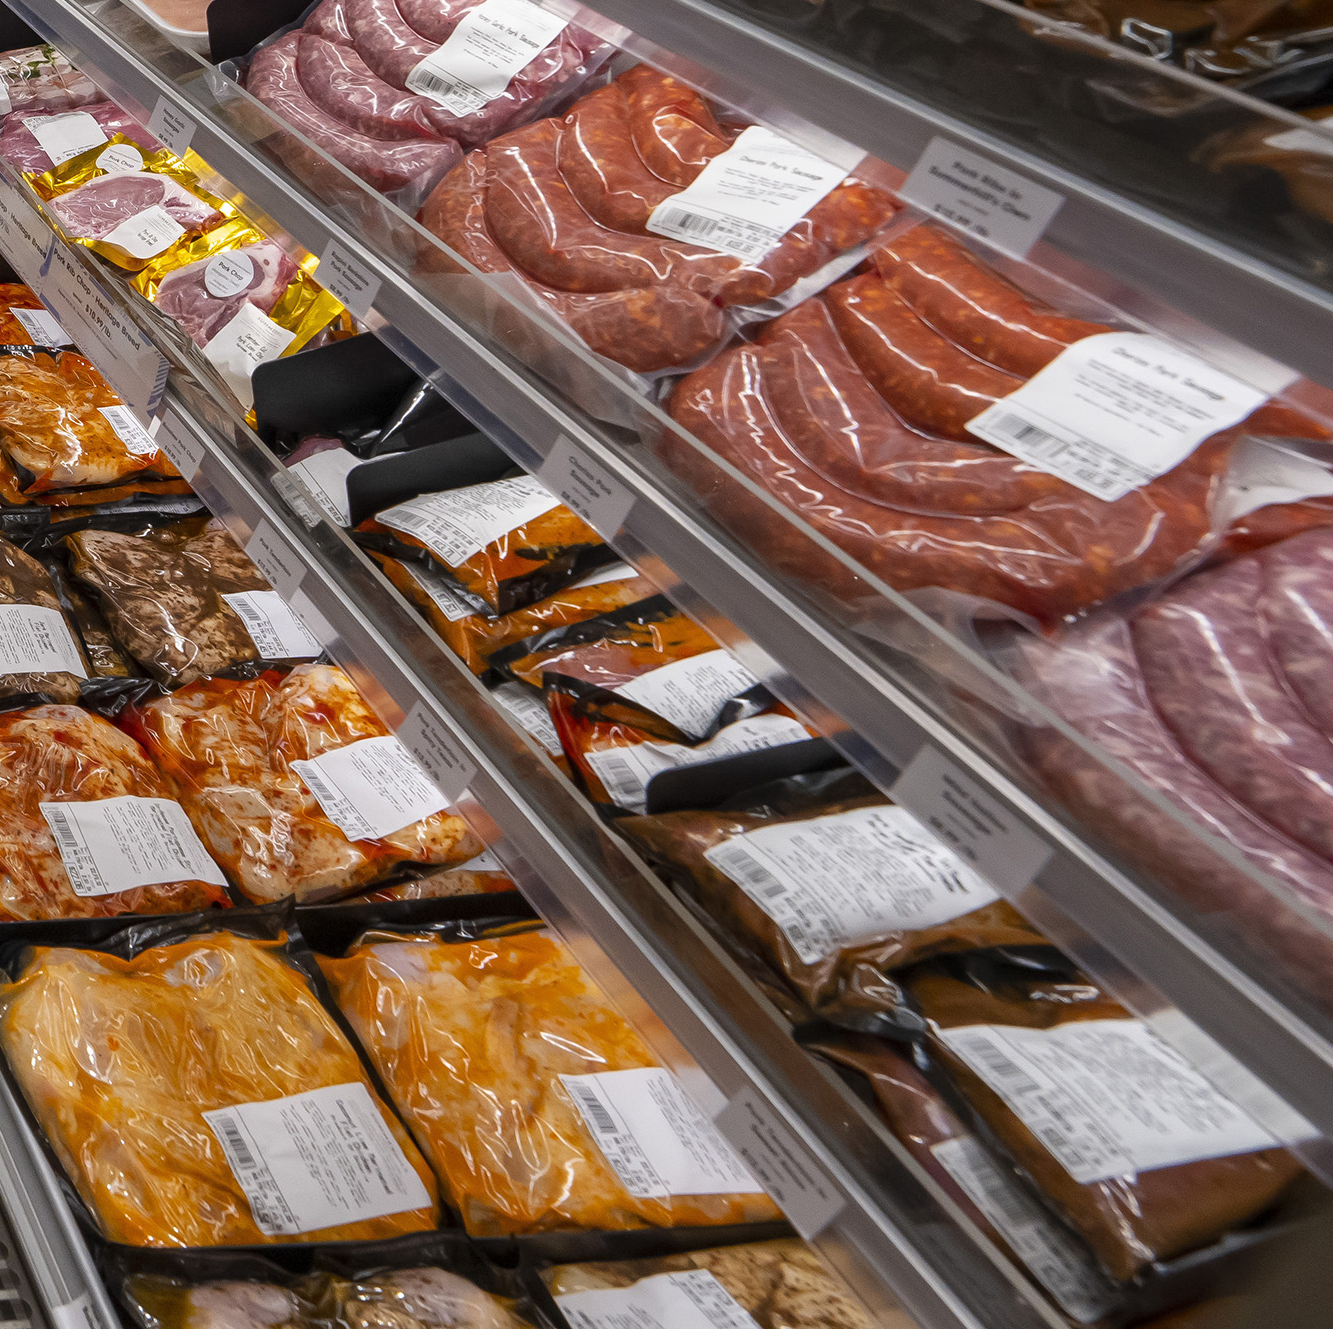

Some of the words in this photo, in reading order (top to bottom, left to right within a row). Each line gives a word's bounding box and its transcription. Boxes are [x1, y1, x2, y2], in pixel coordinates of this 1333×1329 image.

[108, 155, 120, 164] Pork
[120, 159, 135, 169] Chop
[10, 213, 33, 242] Heritage
[31, 238, 47, 259] Breed
[218, 261, 230, 272] Pork
[230, 269, 244, 281] Chop
[53, 248, 67, 267] Pork
[65, 262, 77, 277] Rib
[75, 273, 92, 297] Chop
[94, 297, 121, 331] Heritage
[119, 325, 141, 352] Breed
